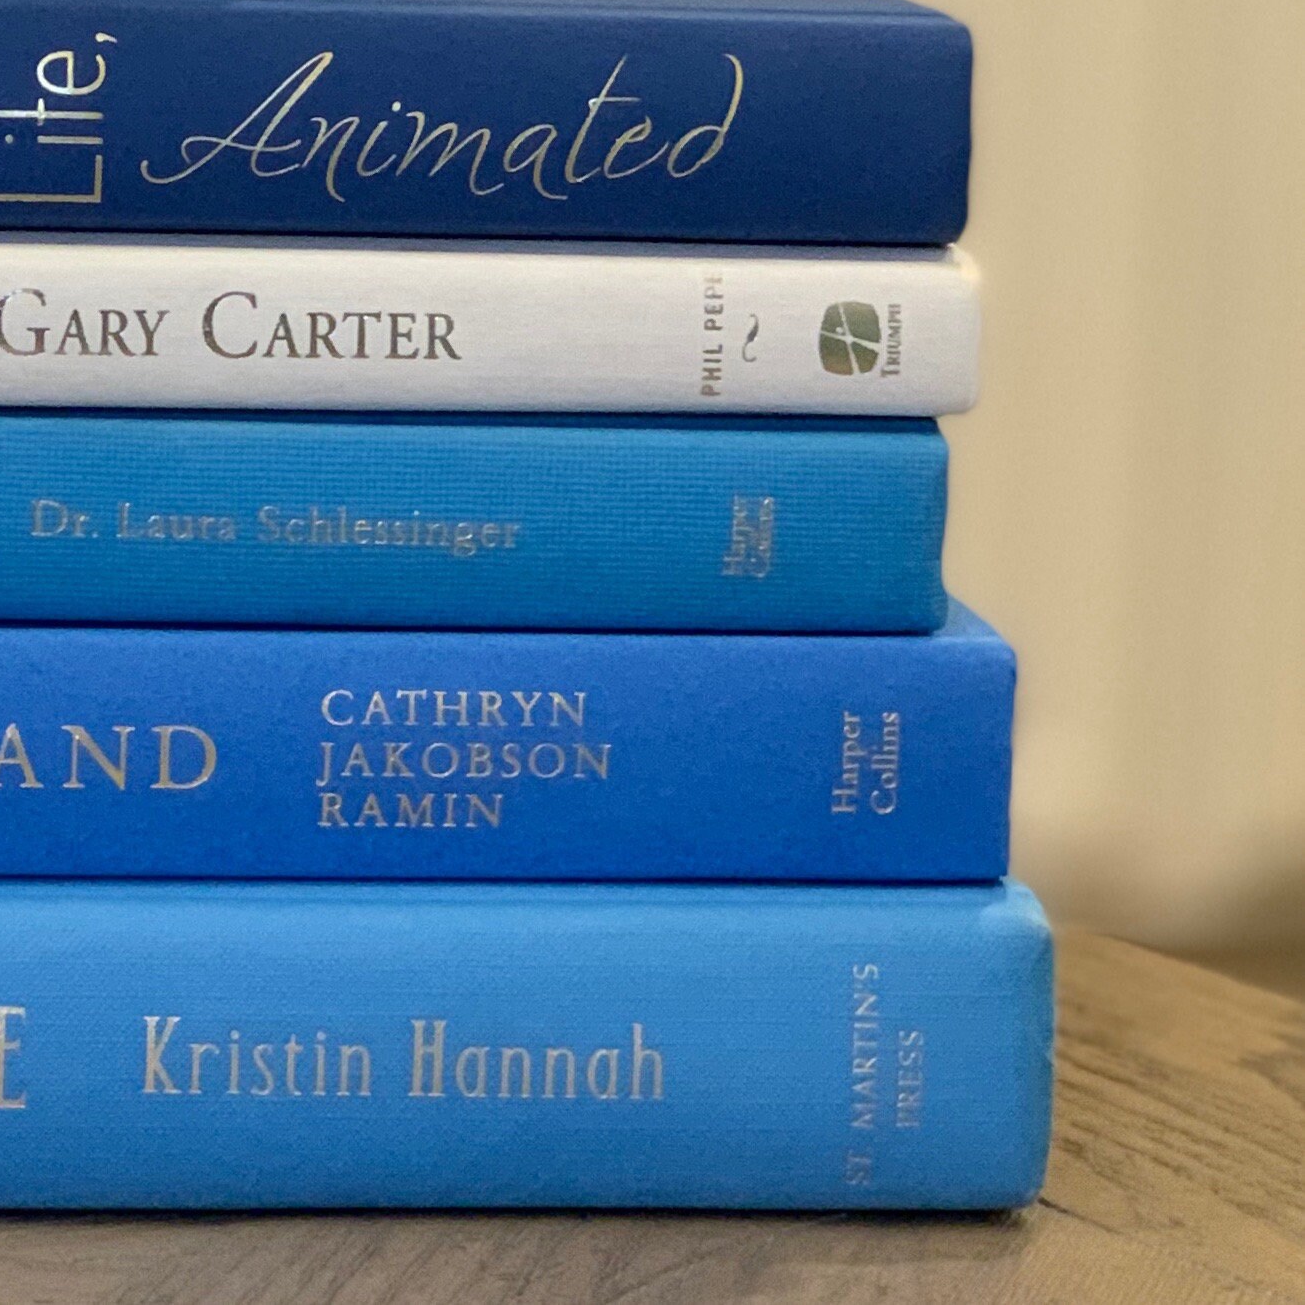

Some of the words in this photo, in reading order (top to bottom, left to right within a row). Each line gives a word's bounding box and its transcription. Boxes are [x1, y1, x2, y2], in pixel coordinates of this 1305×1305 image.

[142, 50, 744, 204] Animated
[201, 291, 462, 362] CARTER
[701, 344, 723, 396] PHIL
[30, 499, 100, 539] Dr.
[115, 501, 238, 542] Laura
[256, 504, 522, 558] Schlessinger
[320, 688, 586, 727] CATHRYN
[315, 741, 612, 788] JAKOBSON
[831, 711, 867, 814] Harper
[870, 711, 900, 815] Collins
[317, 791, 504, 828] RAMIN
[141, 1014, 372, 1096] Kristin
[407, 1018, 664, 1100] Hannah
[896, 1030, 924, 1128] PRESS
